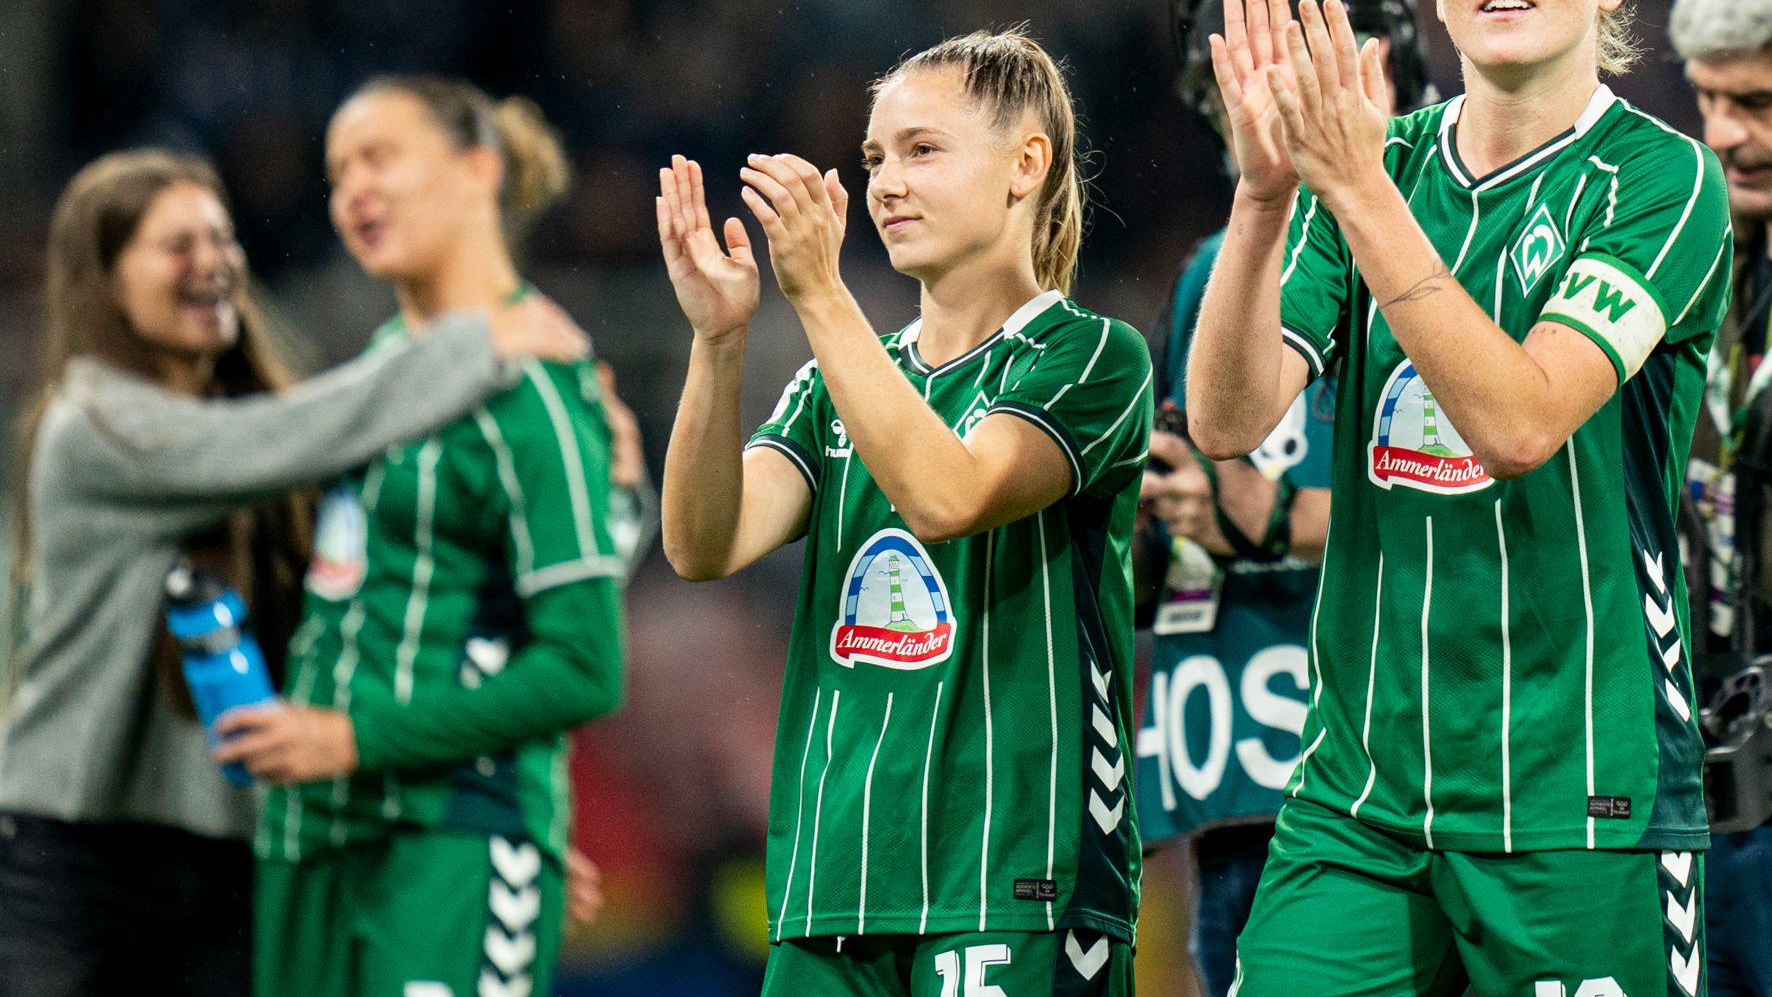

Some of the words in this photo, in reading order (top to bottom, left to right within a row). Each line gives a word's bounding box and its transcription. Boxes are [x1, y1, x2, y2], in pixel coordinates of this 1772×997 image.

[1561, 272, 1637, 324] VW
[836, 628, 948, 656] Ammerländer
[934, 944, 1012, 997] 15
